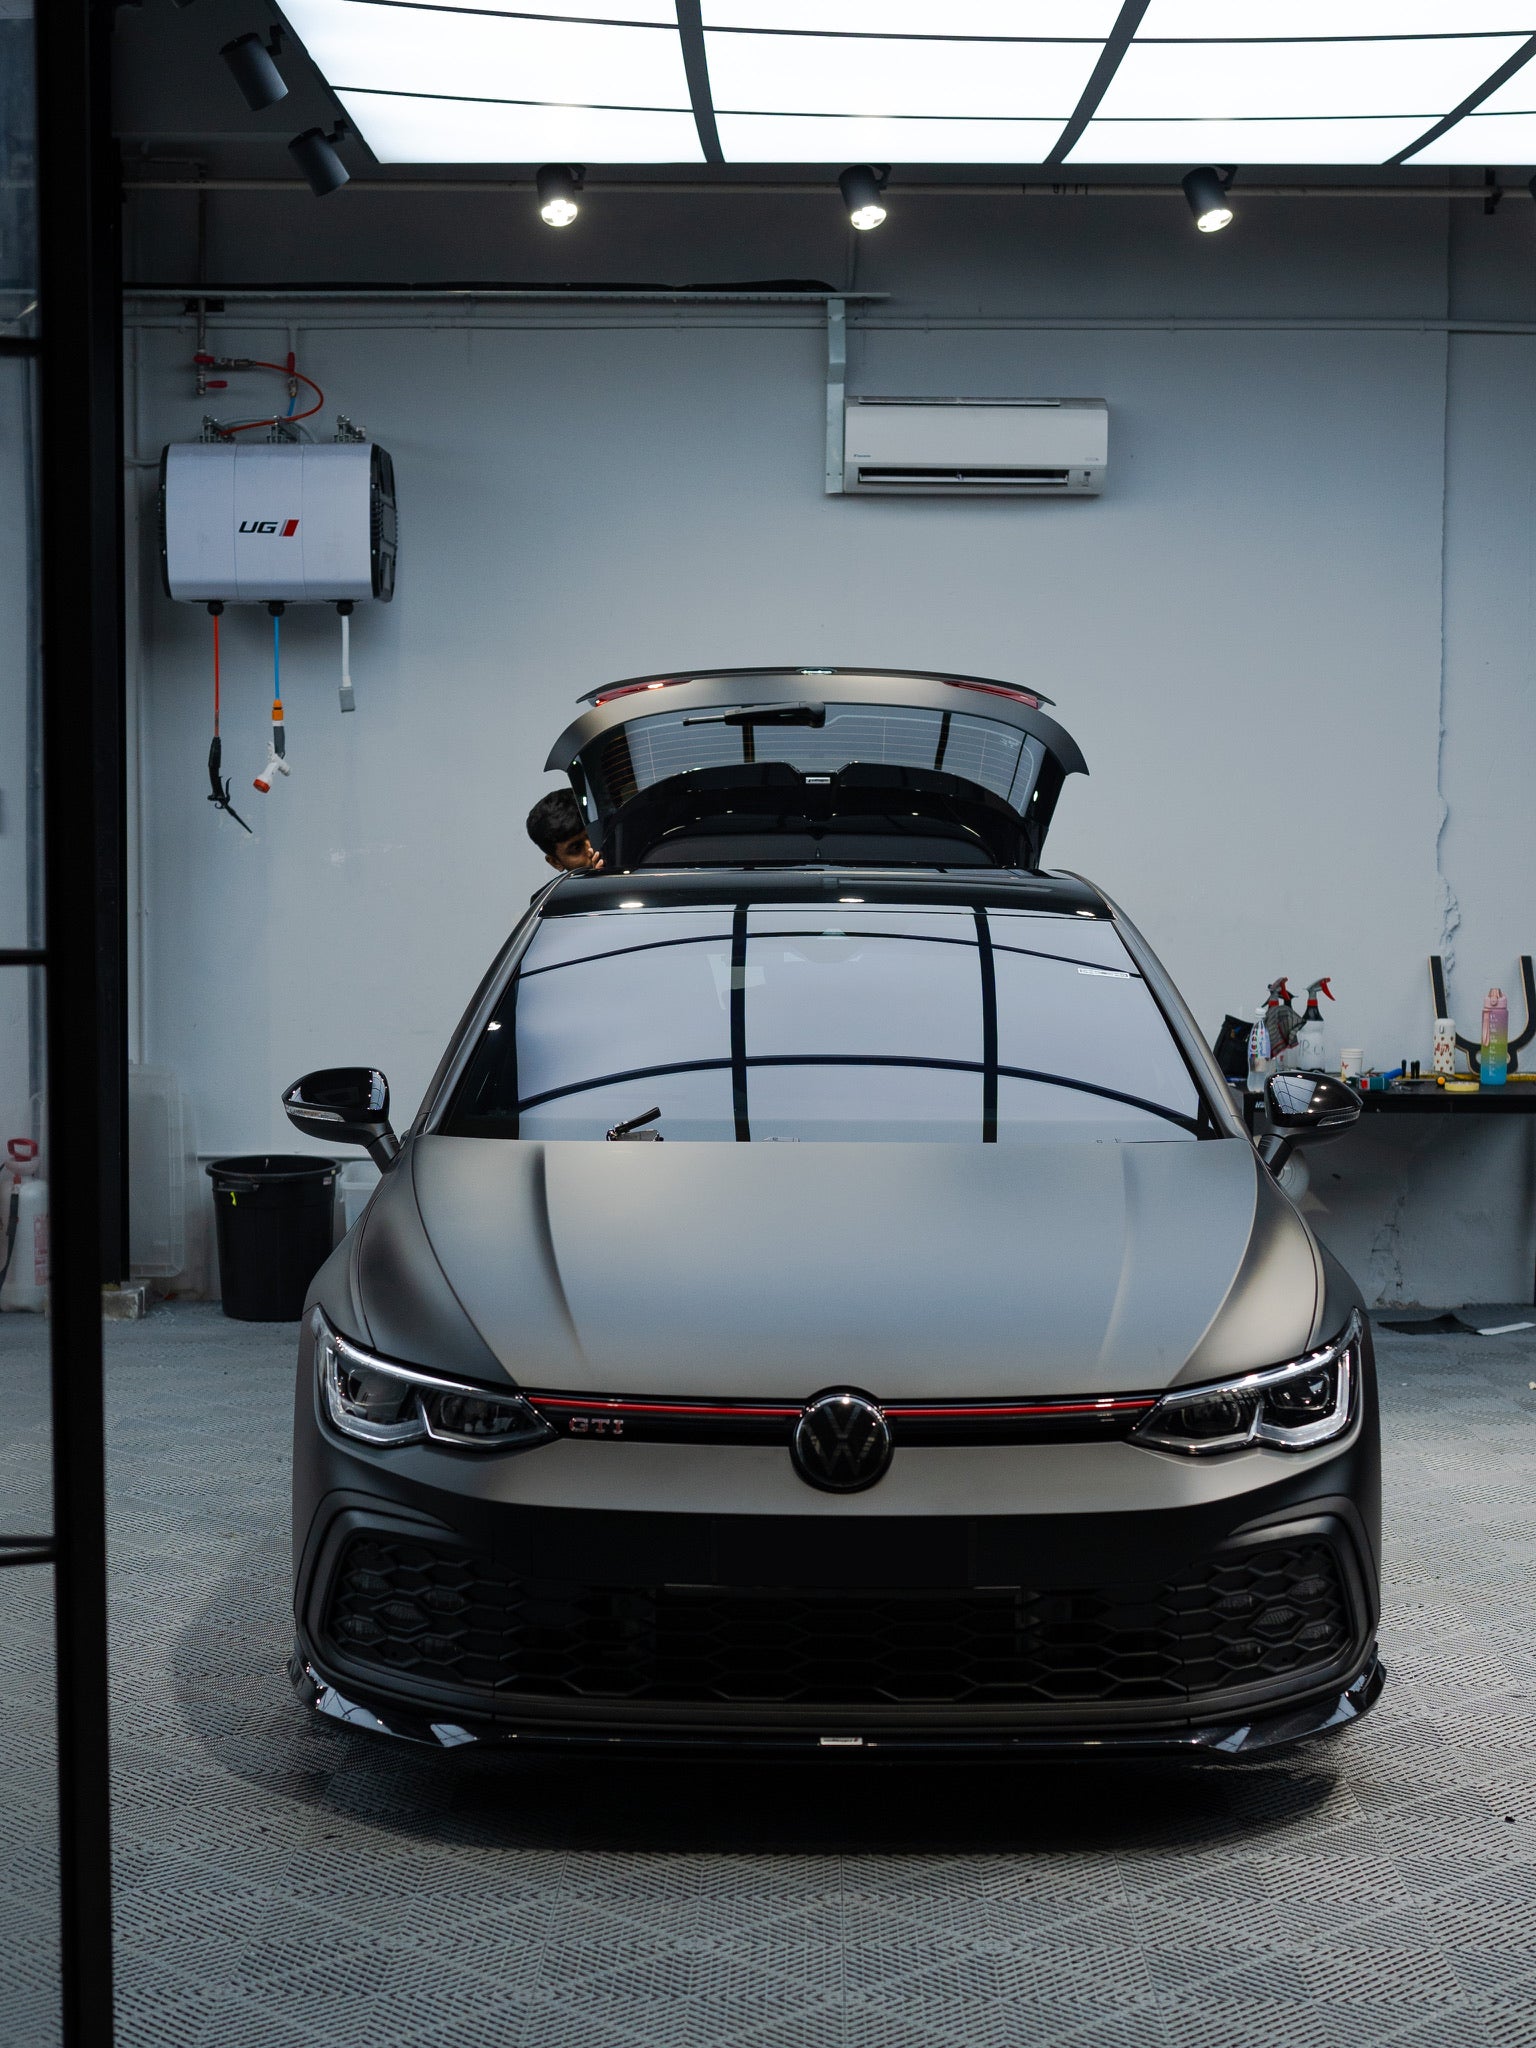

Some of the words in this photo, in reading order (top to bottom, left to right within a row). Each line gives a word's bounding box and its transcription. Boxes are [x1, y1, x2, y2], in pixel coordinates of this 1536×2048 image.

[238, 520, 279, 534] UG
[569, 1416, 624, 1435] GTI
[801, 1404, 882, 1478] VW
